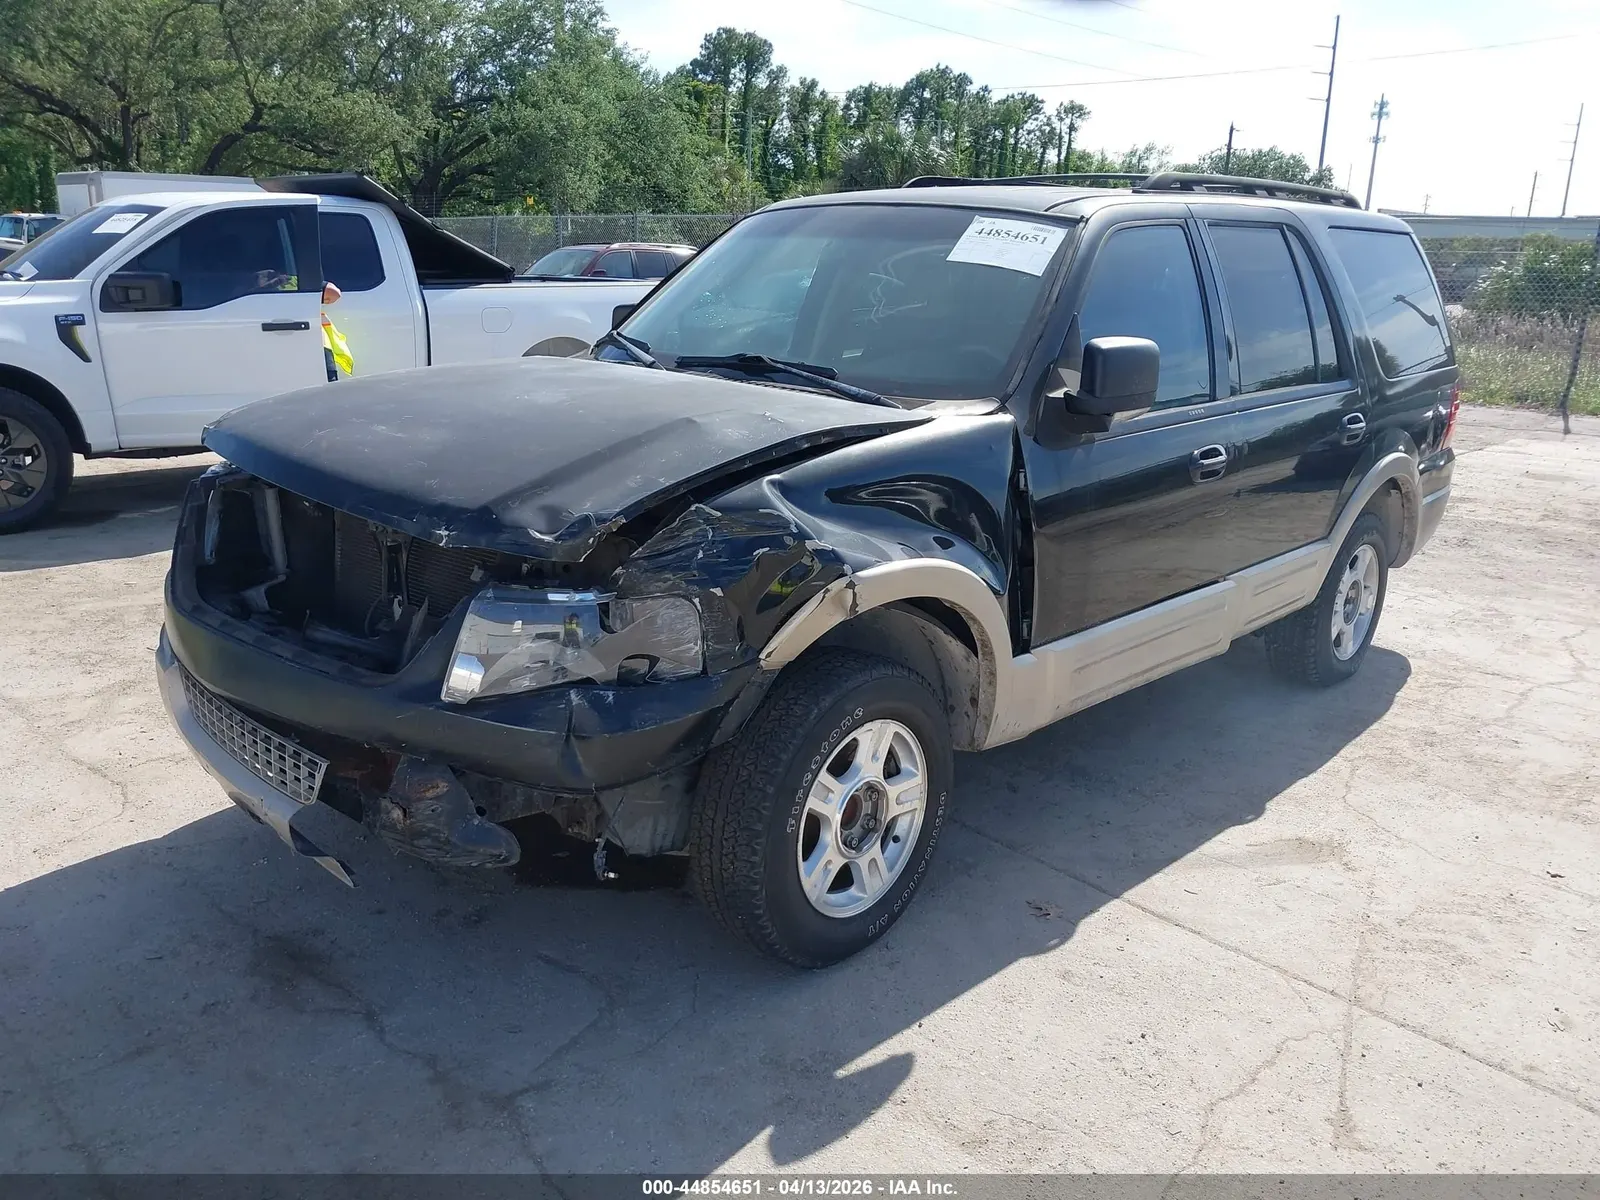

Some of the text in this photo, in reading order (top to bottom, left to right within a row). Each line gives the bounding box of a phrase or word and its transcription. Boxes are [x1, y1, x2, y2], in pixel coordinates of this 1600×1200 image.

[975, 227, 1048, 245] 44854651
[867, 791, 946, 937] DESTINATION A/T
